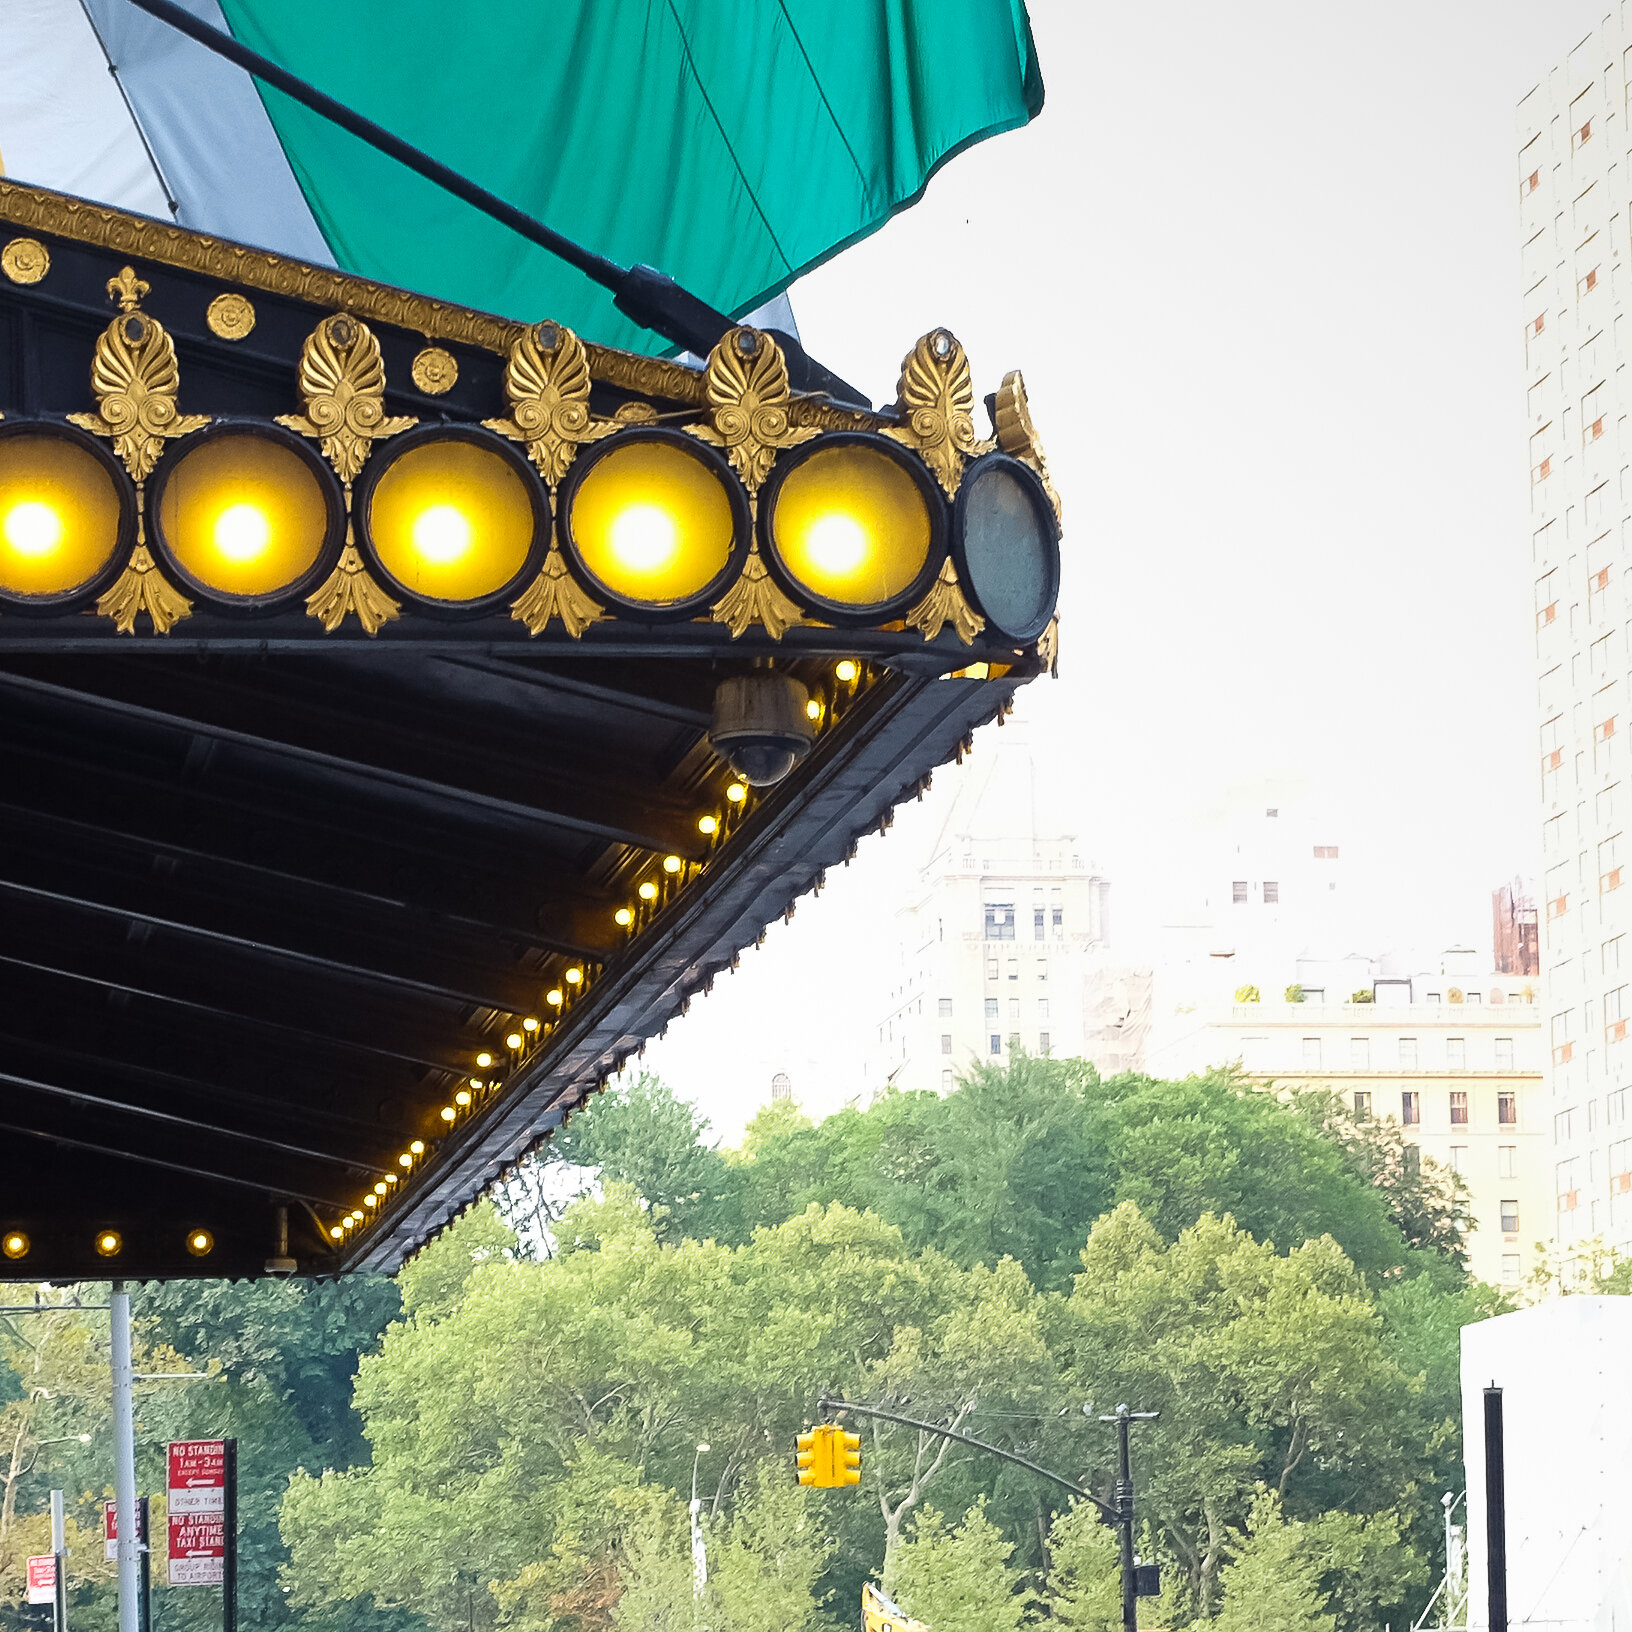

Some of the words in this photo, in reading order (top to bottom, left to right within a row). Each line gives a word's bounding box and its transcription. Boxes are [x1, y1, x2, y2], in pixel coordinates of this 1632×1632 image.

[172, 1446, 186, 1456] NO
[188, 1445, 224, 1456] STANDIN
[204, 1497, 223, 1505] TIME
[172, 1516, 185, 1526] NO
[188, 1515, 224, 1525] STANDIN
[179, 1525, 224, 1537] ANYTIME
[176, 1538, 196, 1548] TAXI
